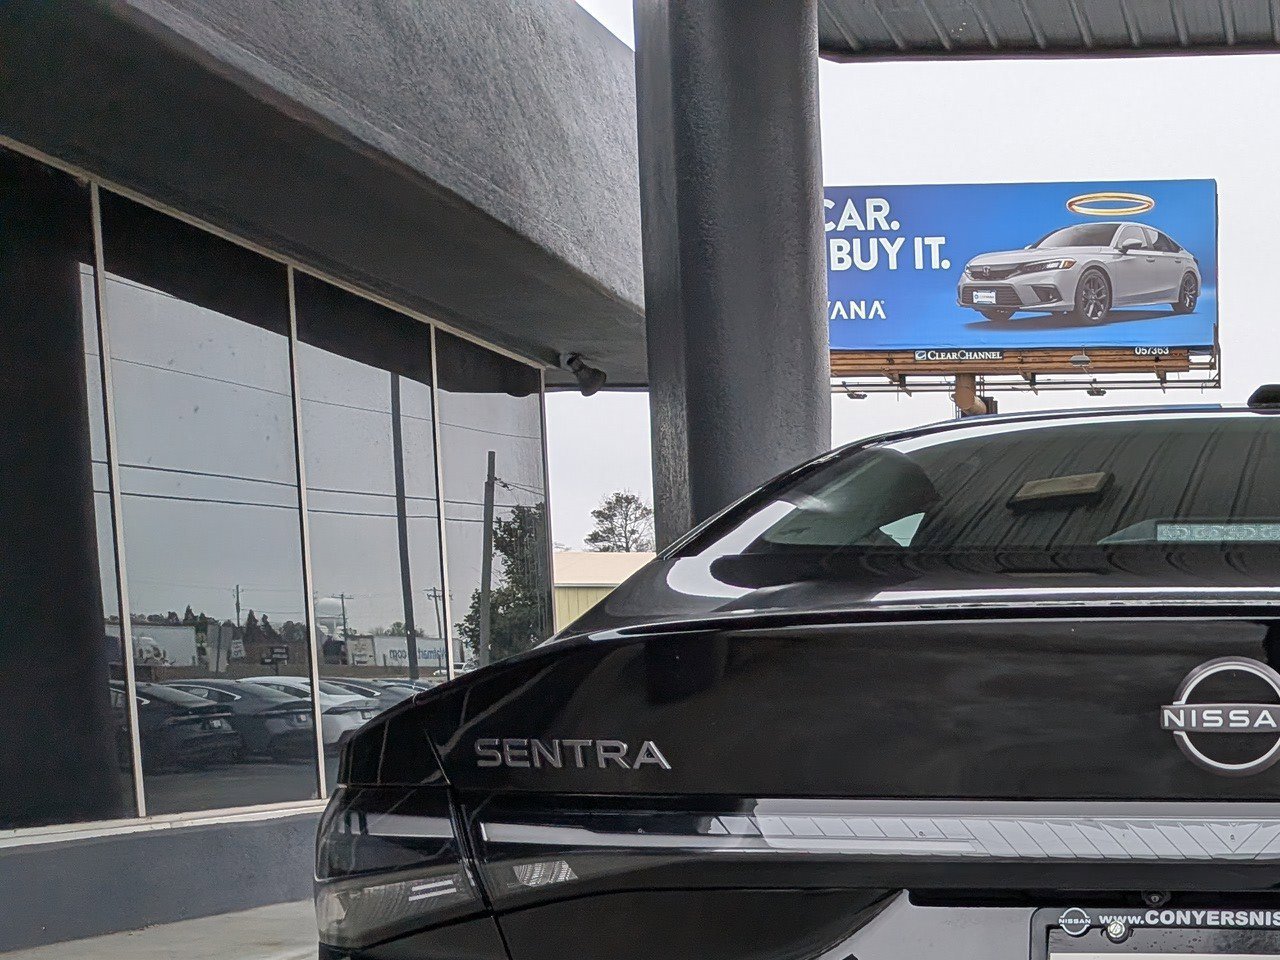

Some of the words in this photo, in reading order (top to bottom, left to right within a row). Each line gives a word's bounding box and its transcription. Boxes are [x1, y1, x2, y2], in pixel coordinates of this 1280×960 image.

[829, 237, 905, 271] BUY
[914, 236, 951, 270] IT.
[474, 738, 672, 770] SENTRA
